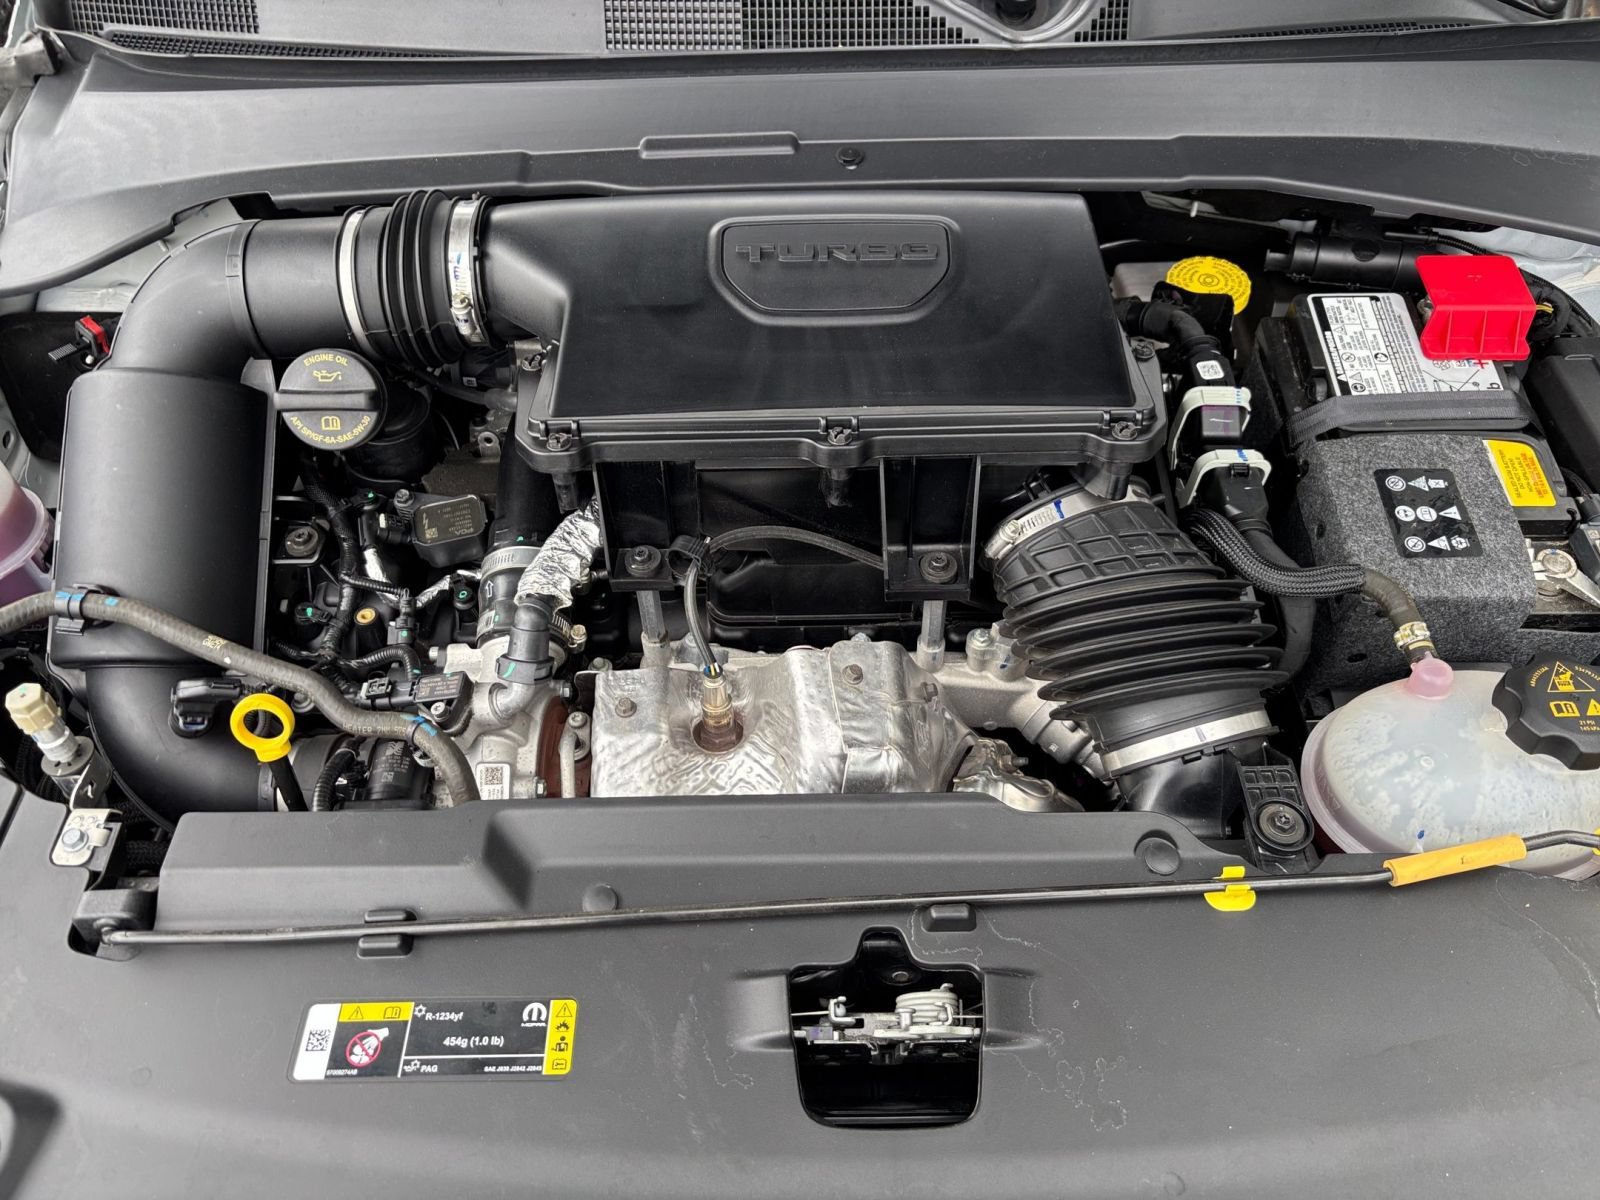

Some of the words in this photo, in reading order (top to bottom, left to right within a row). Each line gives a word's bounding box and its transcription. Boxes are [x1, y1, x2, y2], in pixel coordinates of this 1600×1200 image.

[736, 243, 940, 263] TURBO
[303, 353, 334, 366] ENGINE
[335, 355, 349, 366] OIL
[290, 416, 304, 429] API
[342, 720, 372, 734] HEATER
[425, 1012, 464, 1022] R-1234yf
[443, 1037, 467, 1048] 454g
[470, 1036, 488, 1048] (1.0
[490, 1036, 504, 1047] lb)
[420, 1065, 438, 1073] PAG
